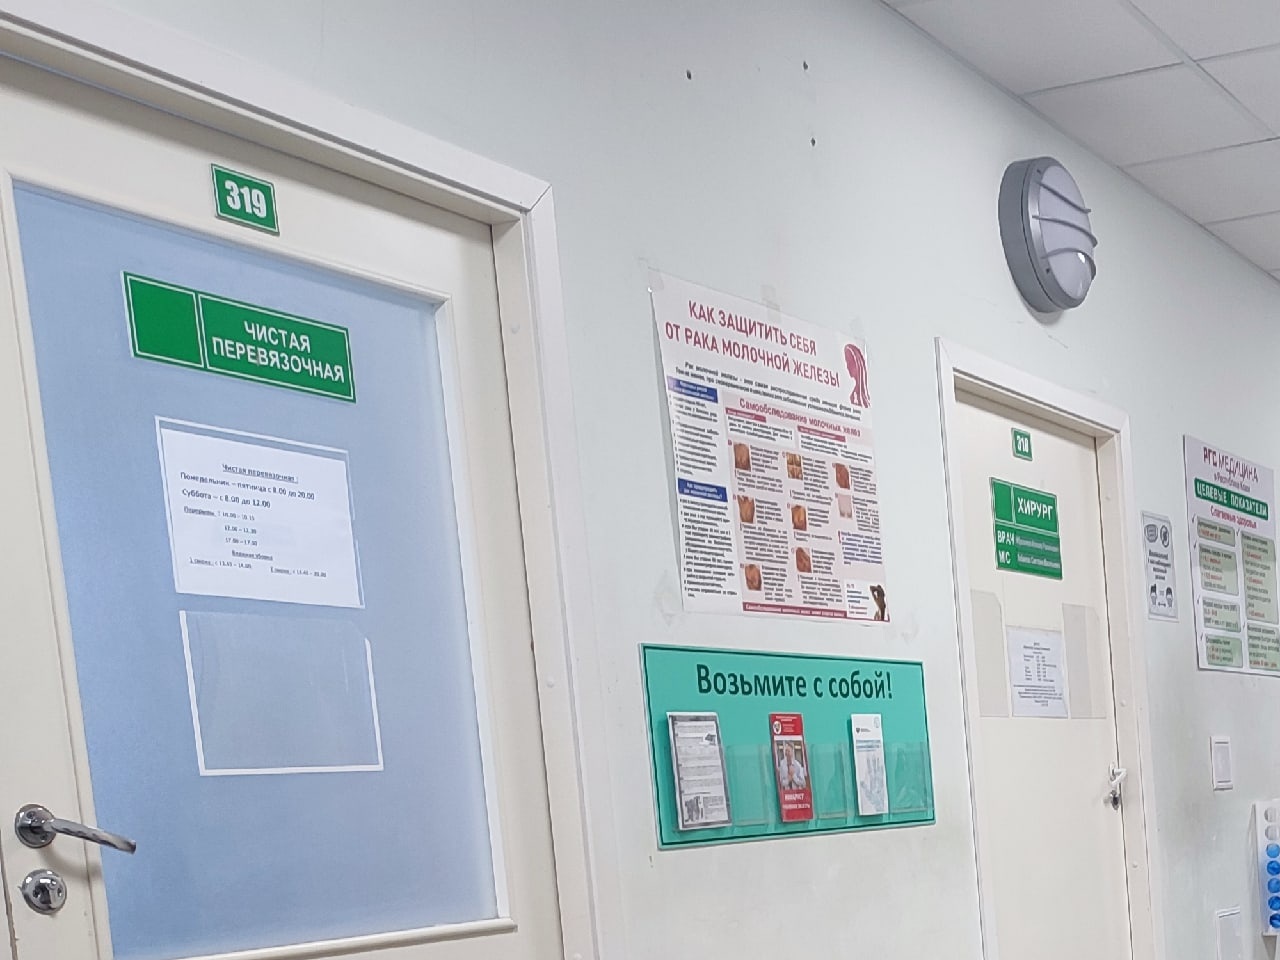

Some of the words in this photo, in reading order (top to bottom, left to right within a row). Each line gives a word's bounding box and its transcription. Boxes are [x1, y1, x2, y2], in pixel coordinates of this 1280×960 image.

[225, 180, 266, 218] 319
[244, 320, 311, 353] ЧИСТАЯ
[688, 300, 715, 325] КАК
[718, 310, 788, 345] ЗАЩИТИТЬ
[789, 332, 817, 356] СЕБЯ
[211, 336, 345, 383] ПЕРЕВЯЗОЧНАЯ
[665, 321, 681, 341] ОТ
[684, 327, 719, 354] РАКА
[721, 338, 791, 373] МОЛОЧНОЙ
[792, 359, 840, 388] ЖЕЛЕЗЫ
[1203, 446, 1217, 467] РГС
[1218, 453, 1258, 483] МЕДИЦИНА
[182, 488, 212, 500] Суббота
[1016, 497, 1053, 521] ХИРУРГ
[1196, 481, 1227, 503] ЦЕЛЕВЫЕ
[1230, 493, 1268, 517] ПОКАЗАТЕЛИ
[997, 530, 1015, 546] ВРАЧ
[998, 550, 1011, 564] МС
[696, 664, 807, 698] Возьмите
[813, 677, 823, 698] с
[828, 671, 893, 699] собой!
